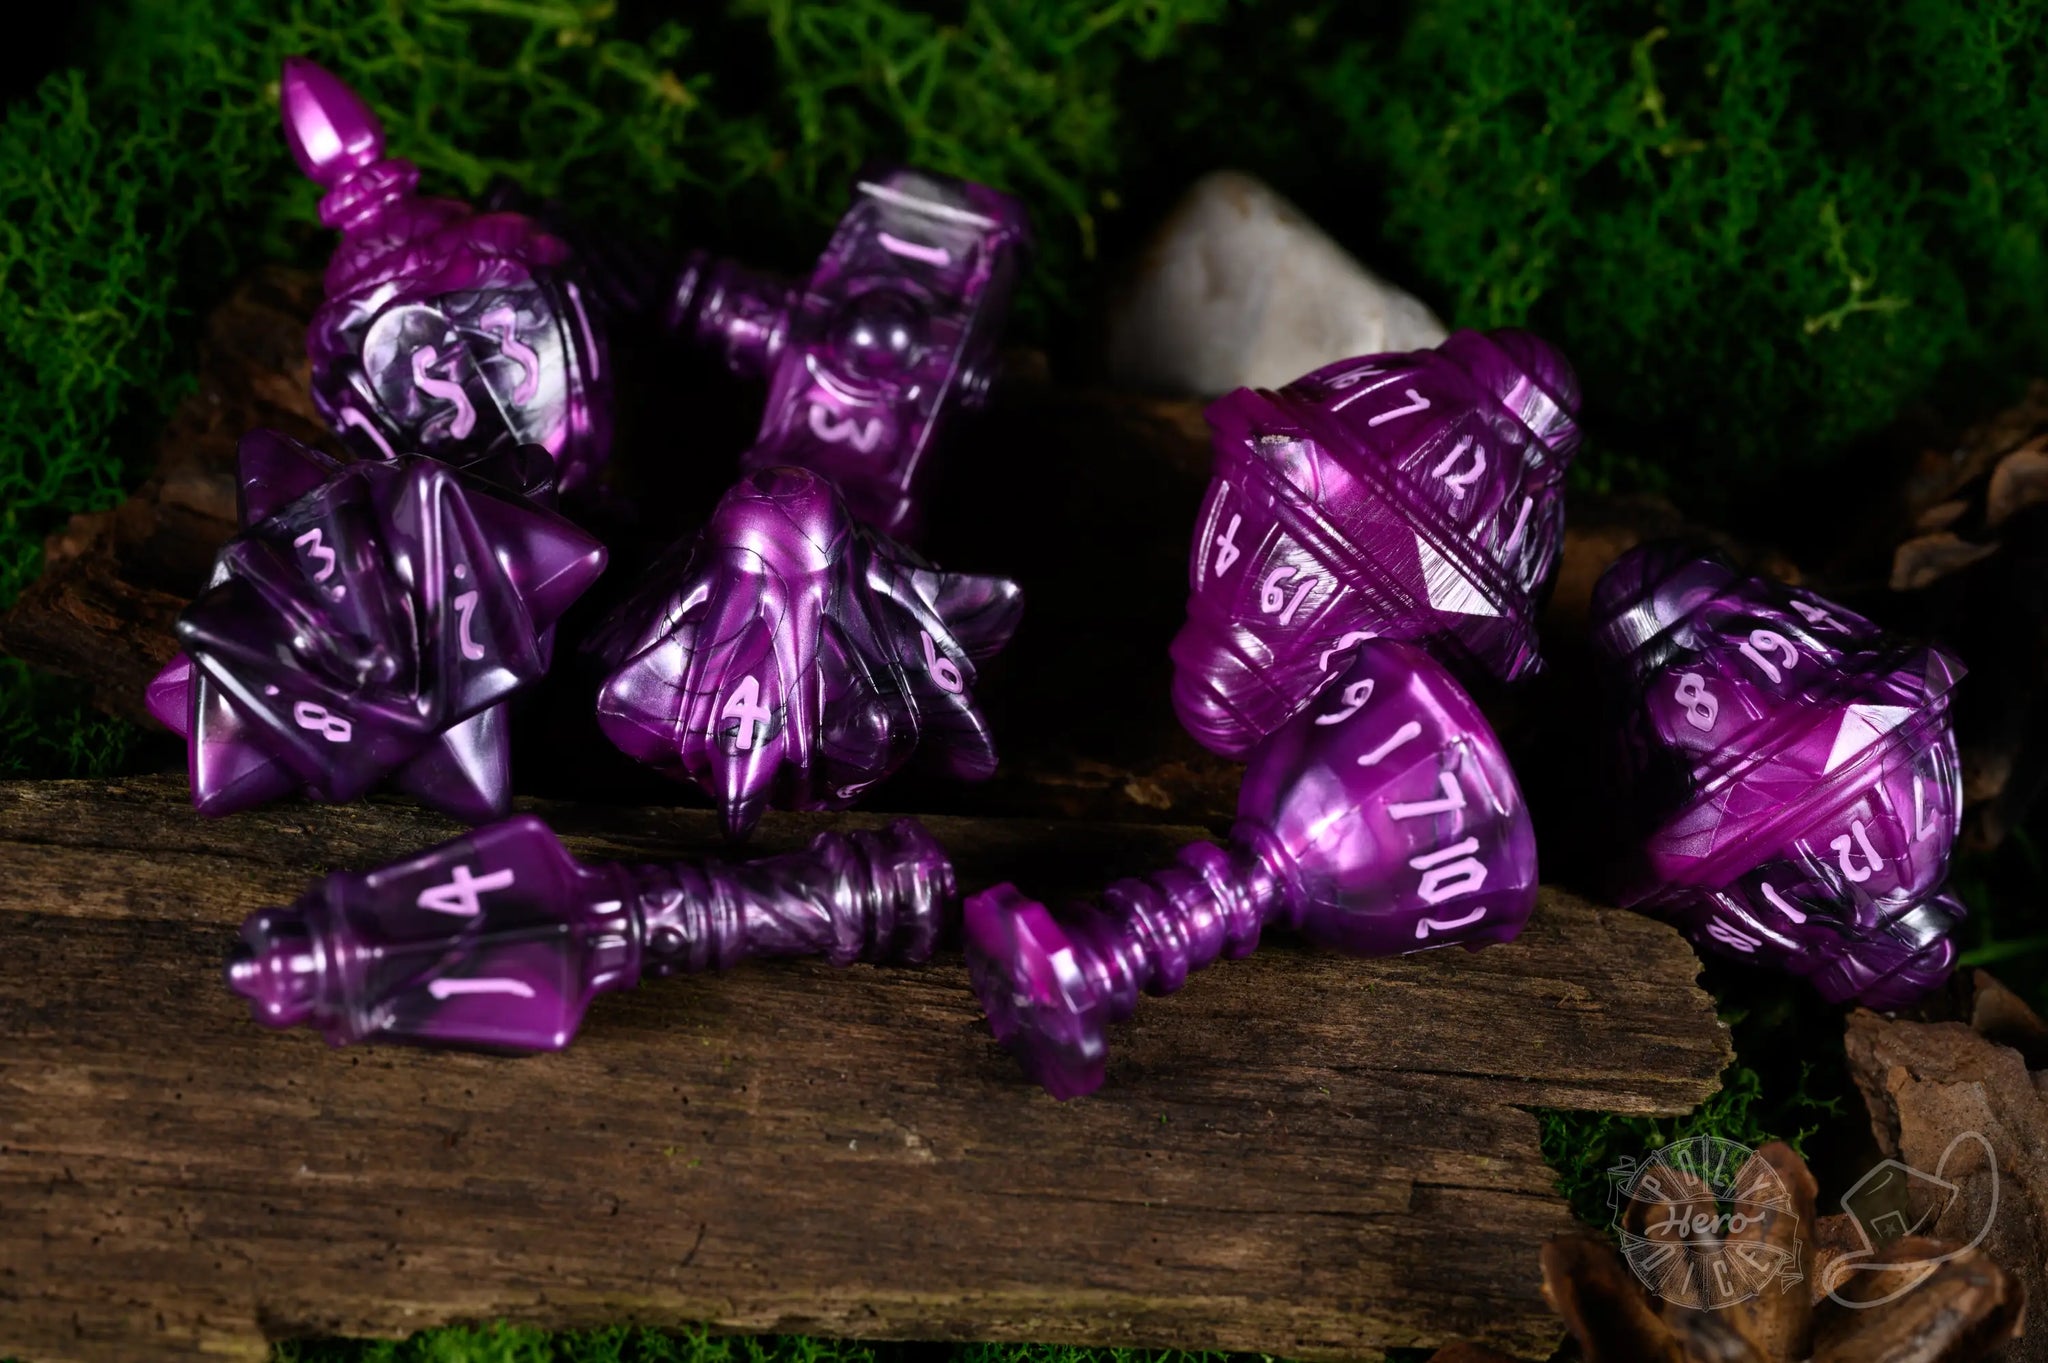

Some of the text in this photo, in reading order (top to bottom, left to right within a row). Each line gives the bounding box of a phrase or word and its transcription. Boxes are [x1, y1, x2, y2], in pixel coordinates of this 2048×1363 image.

[1368, 388, 1431, 427] 7
[1432, 434, 1486, 500] 12
[920, 630, 963, 694] 6
[1738, 628, 1799, 684] 19
[722, 674, 771, 750] 4
[1674, 672, 1719, 732] 8
[1387, 770, 1466, 820] 7
[1409, 836, 1488, 905] 10
[1830, 819, 1884, 882] 12
[417, 865, 514, 917] 4
